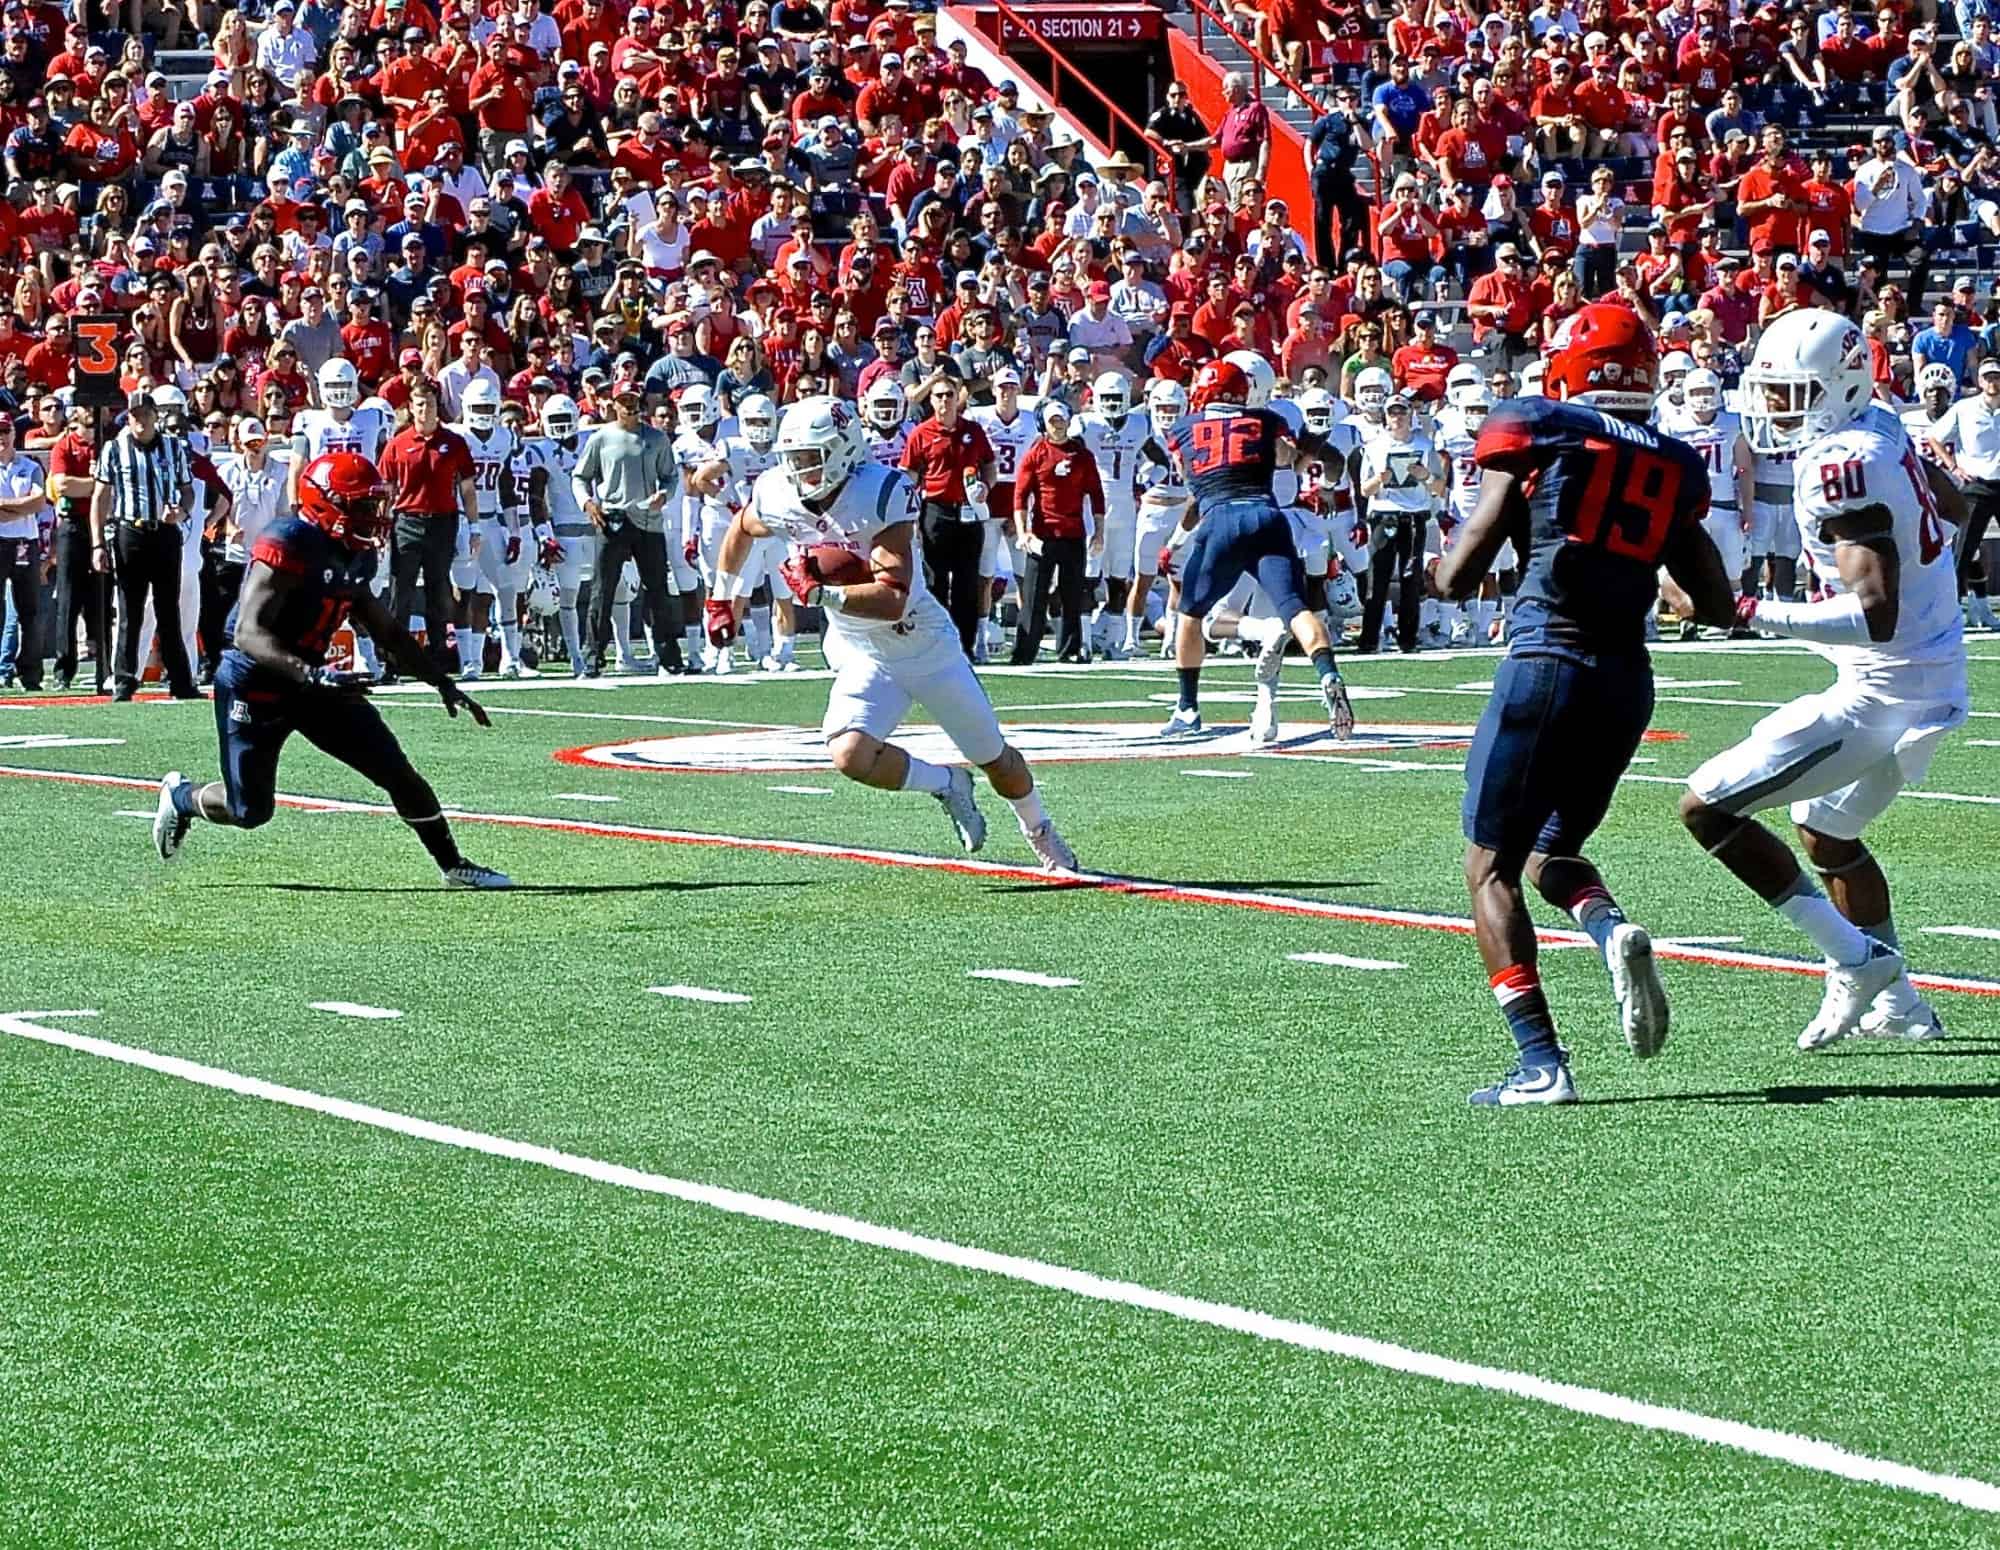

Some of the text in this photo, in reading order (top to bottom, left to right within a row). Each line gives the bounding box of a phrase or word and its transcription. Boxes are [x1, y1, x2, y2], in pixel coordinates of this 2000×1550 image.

[1041, 18, 1102, 37] SECTION
[1107, 18, 1122, 37] 21
[905, 277, 928, 308] A
[77, 323, 118, 374] 3
[999, 444, 1016, 475] 3
[1191, 417, 1261, 477] 92
[1112, 450, 1121, 480] 1
[1820, 459, 1867, 502] 80
